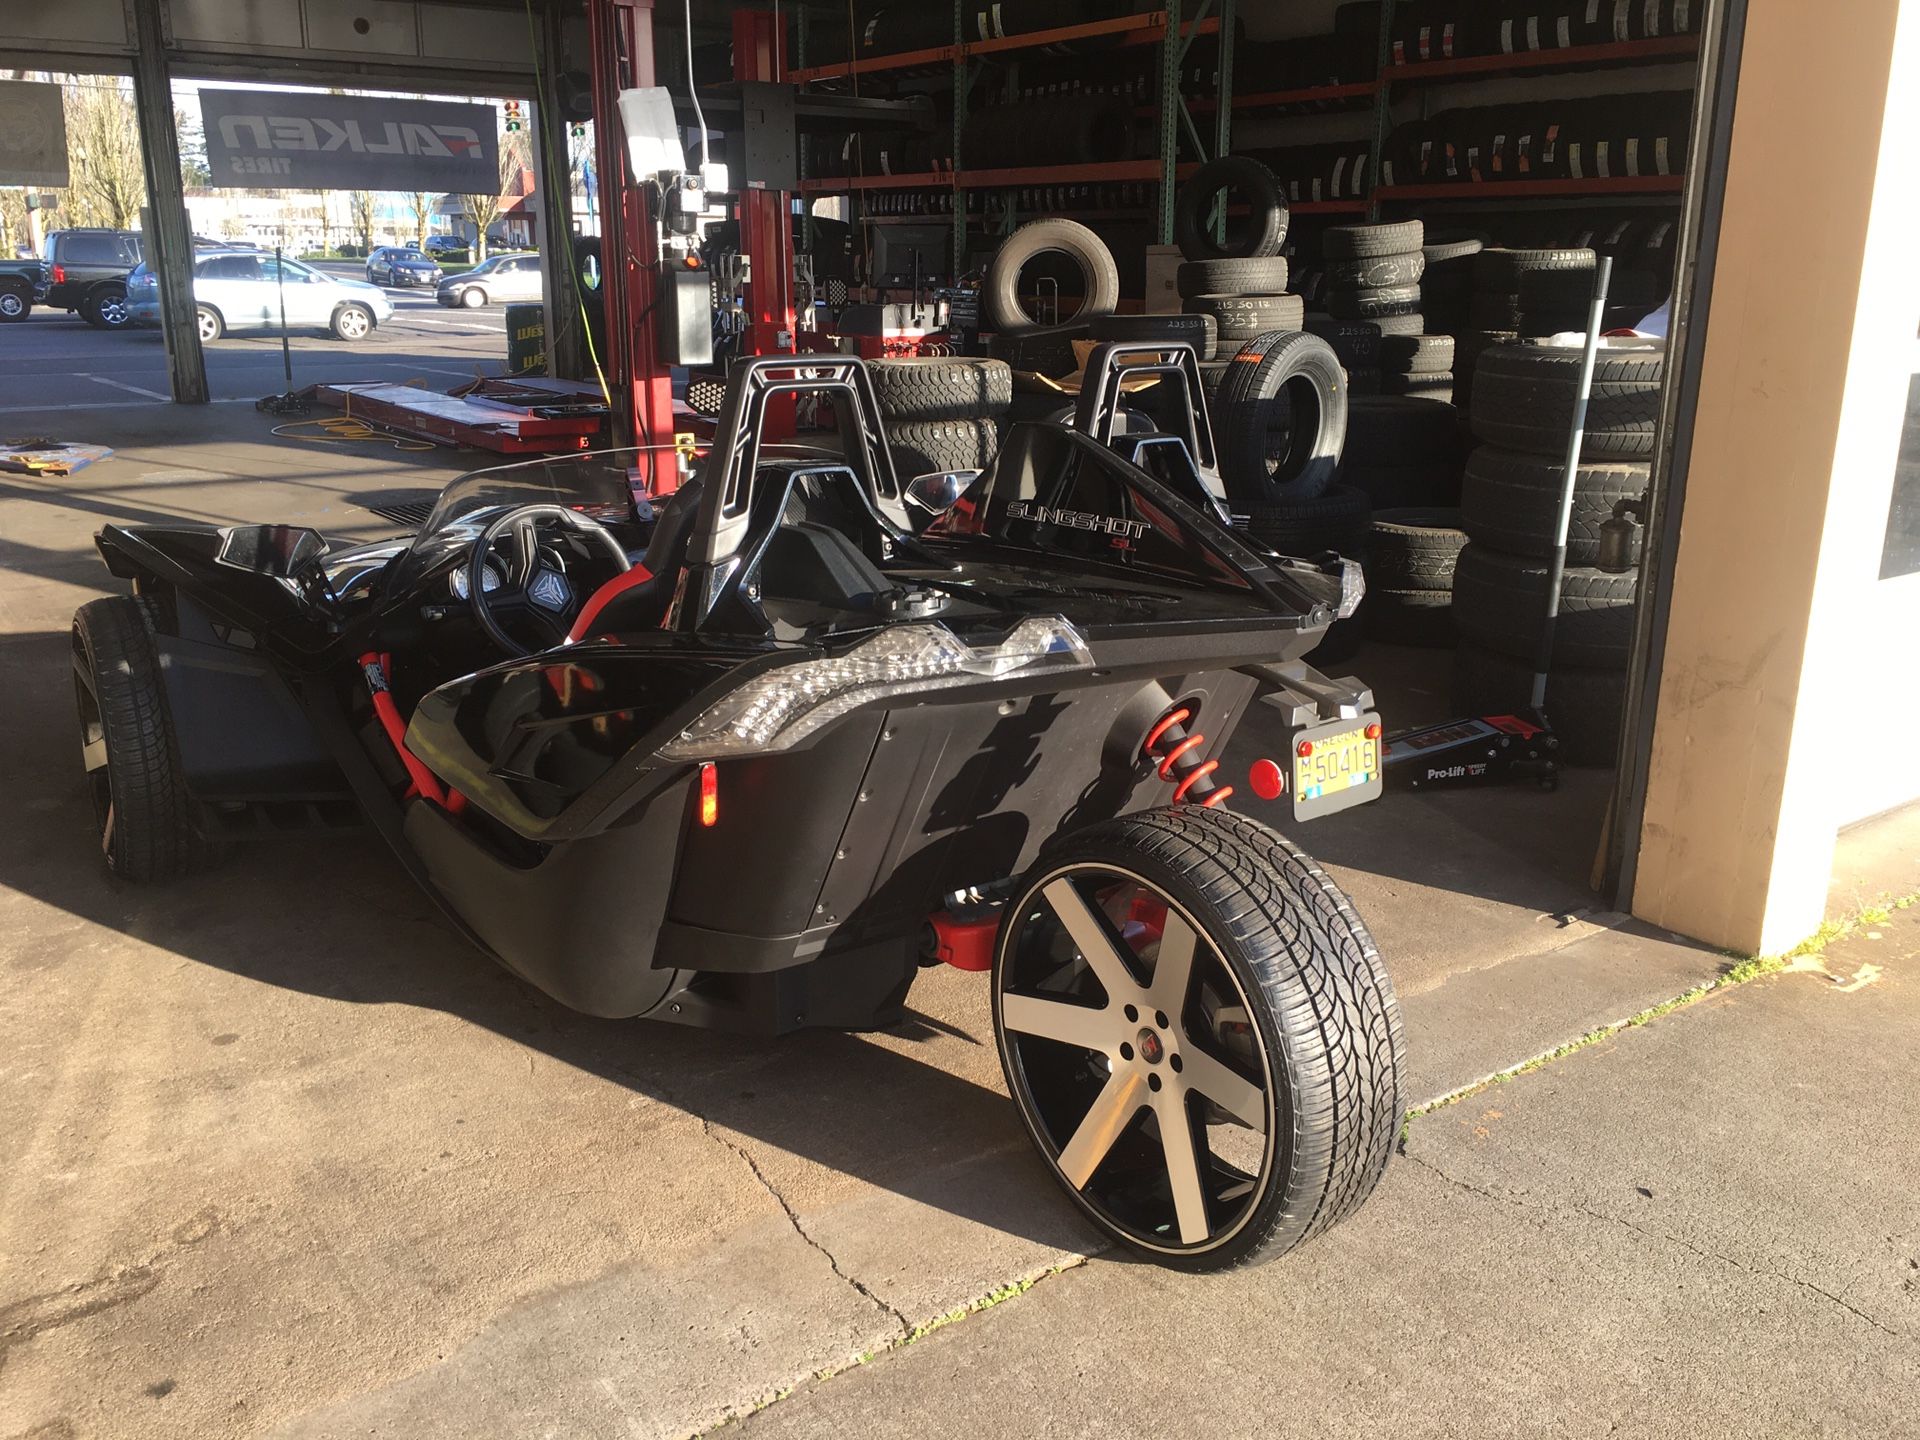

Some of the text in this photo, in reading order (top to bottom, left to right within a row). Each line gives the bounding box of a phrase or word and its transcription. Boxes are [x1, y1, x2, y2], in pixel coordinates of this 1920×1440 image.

[1006, 501, 1151, 539] SLINGSHOT
[1316, 741, 1373, 783] 50416
[1427, 765, 1466, 780] Pro-Lift
